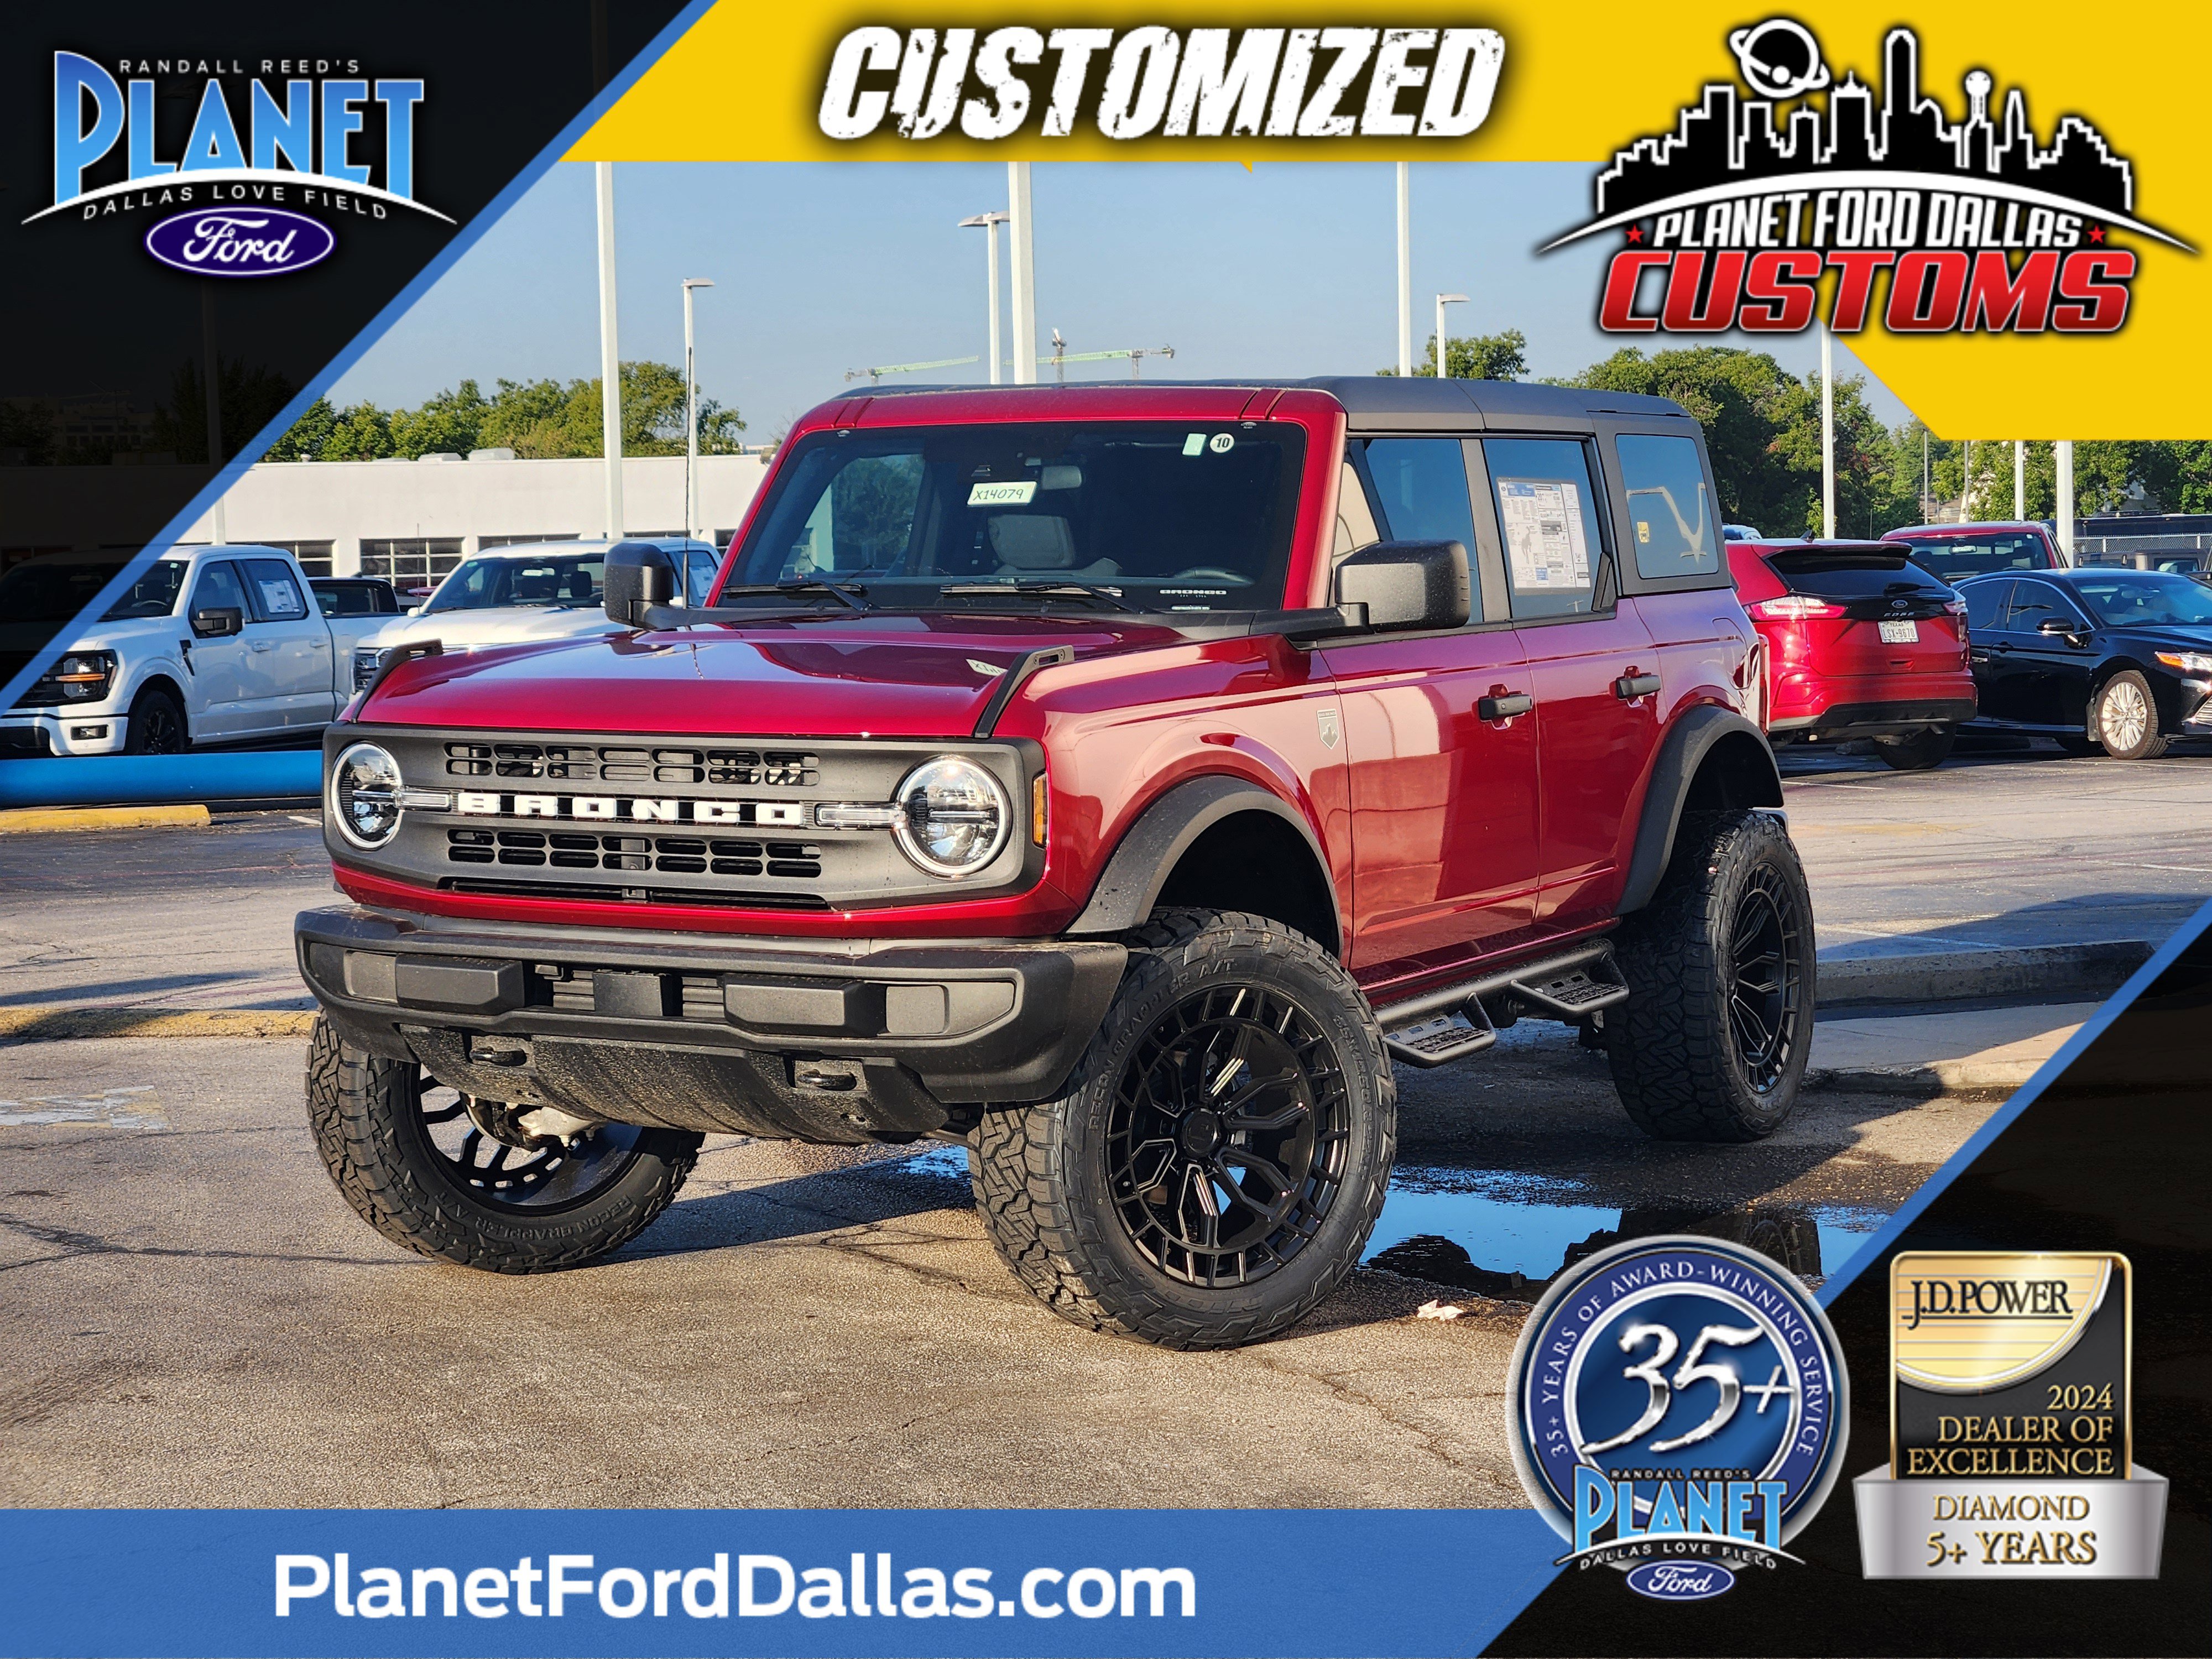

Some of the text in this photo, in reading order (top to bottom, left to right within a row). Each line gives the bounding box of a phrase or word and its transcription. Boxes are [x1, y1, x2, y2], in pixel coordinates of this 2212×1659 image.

[1217, 437, 1230, 448] 10
[973, 489, 1024, 501] X14079
[457, 791, 805, 827] BRONCO
